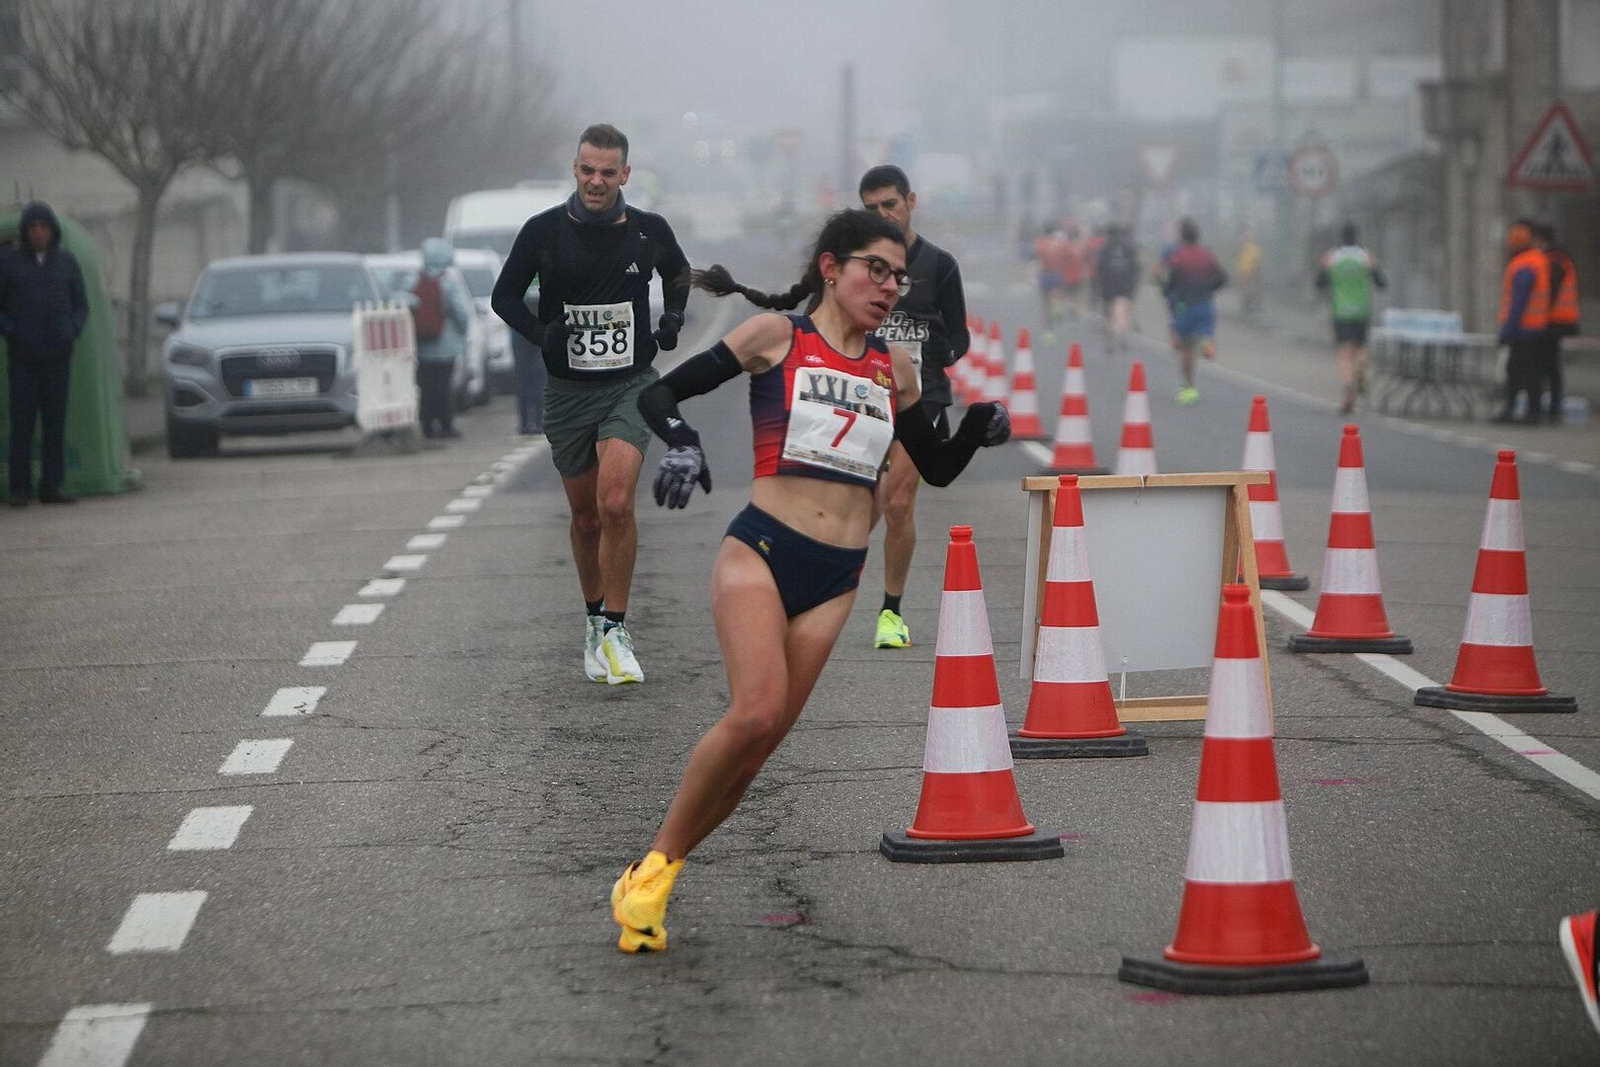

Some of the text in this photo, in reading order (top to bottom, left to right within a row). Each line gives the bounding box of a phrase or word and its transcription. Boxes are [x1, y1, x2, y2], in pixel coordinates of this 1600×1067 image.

[571, 310, 599, 329] XXI
[570, 329, 628, 356] 358
[808, 373, 849, 402] XXI
[831, 408, 858, 447] 7
